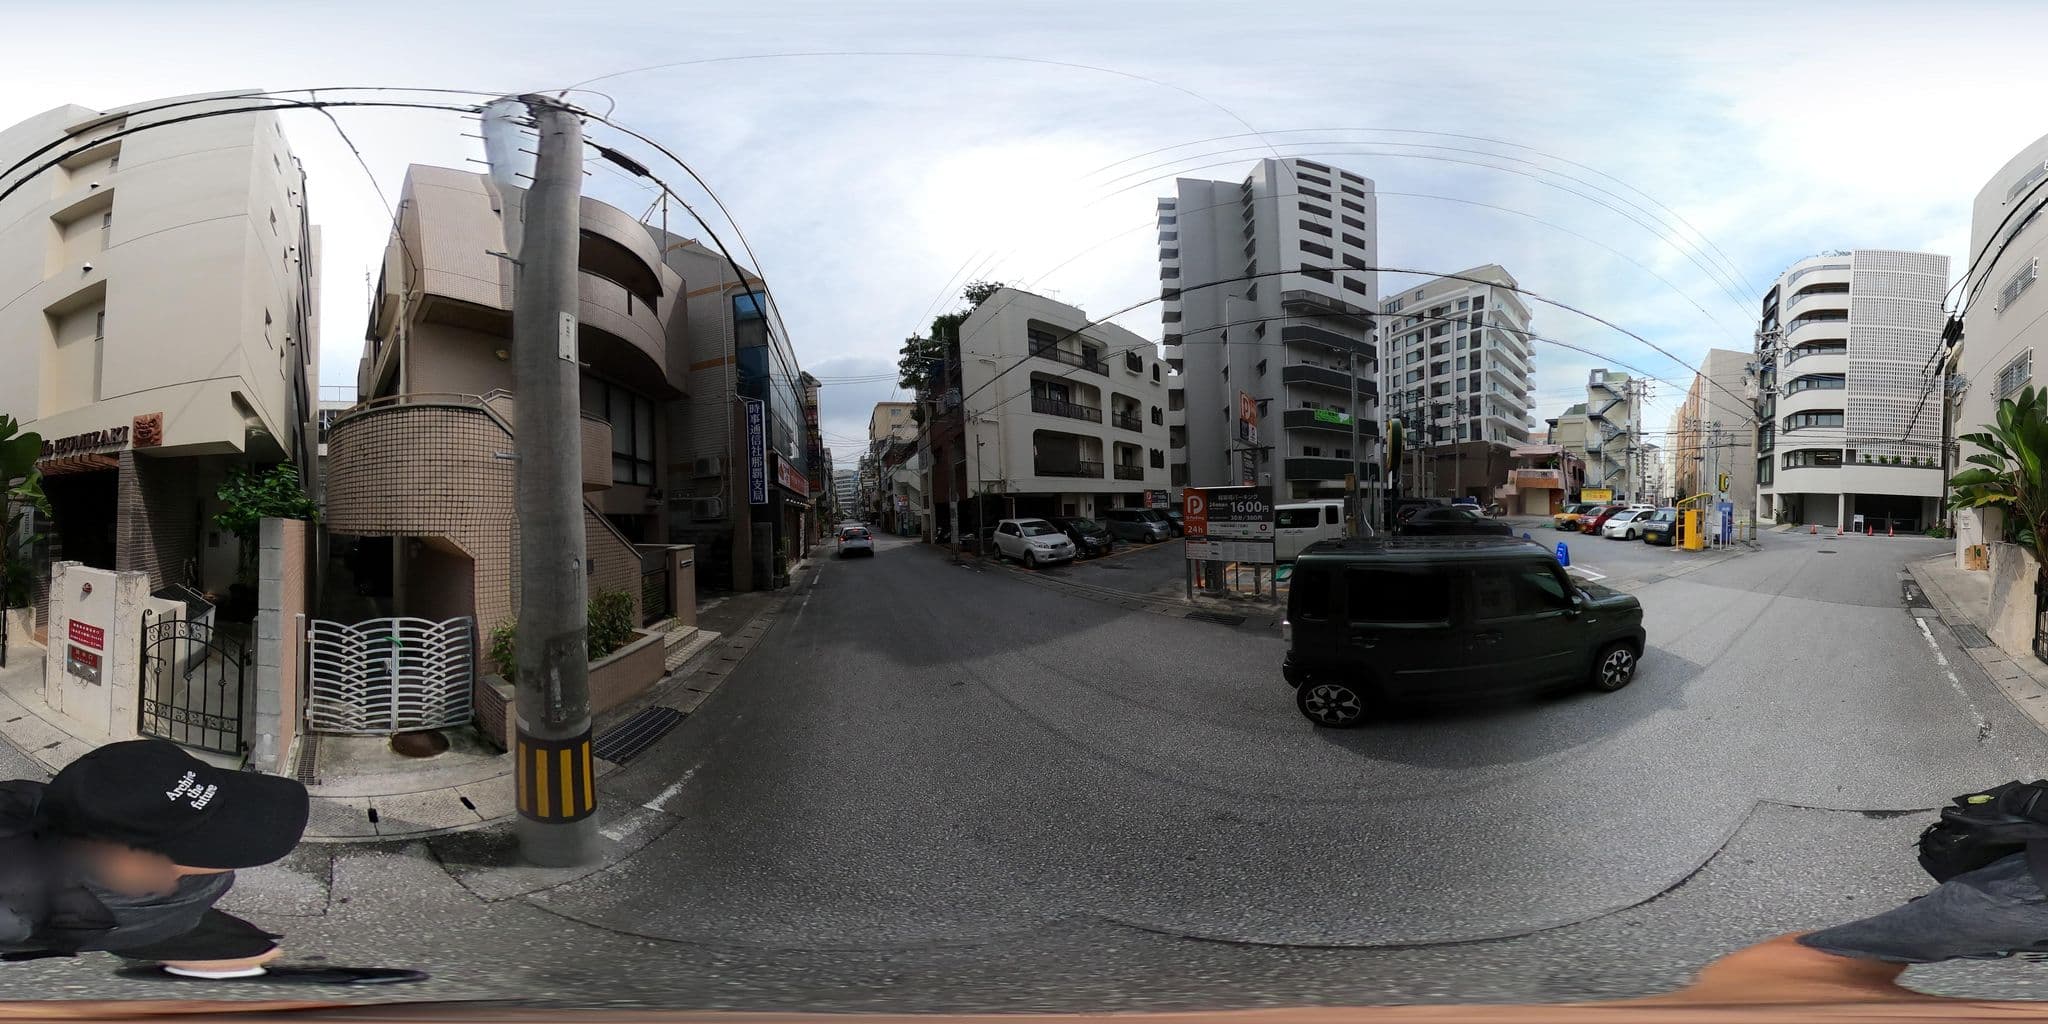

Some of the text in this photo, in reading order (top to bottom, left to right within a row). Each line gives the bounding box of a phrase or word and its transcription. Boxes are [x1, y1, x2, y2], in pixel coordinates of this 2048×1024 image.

[55, 426, 129, 452] IZUMIZAKI
[1230, 501, 1269, 512] 1600円
[1187, 525, 1203, 534] 24h
[166, 770, 196, 801] Archie
[187, 784, 204, 799] the
[190, 784, 218, 810] future
